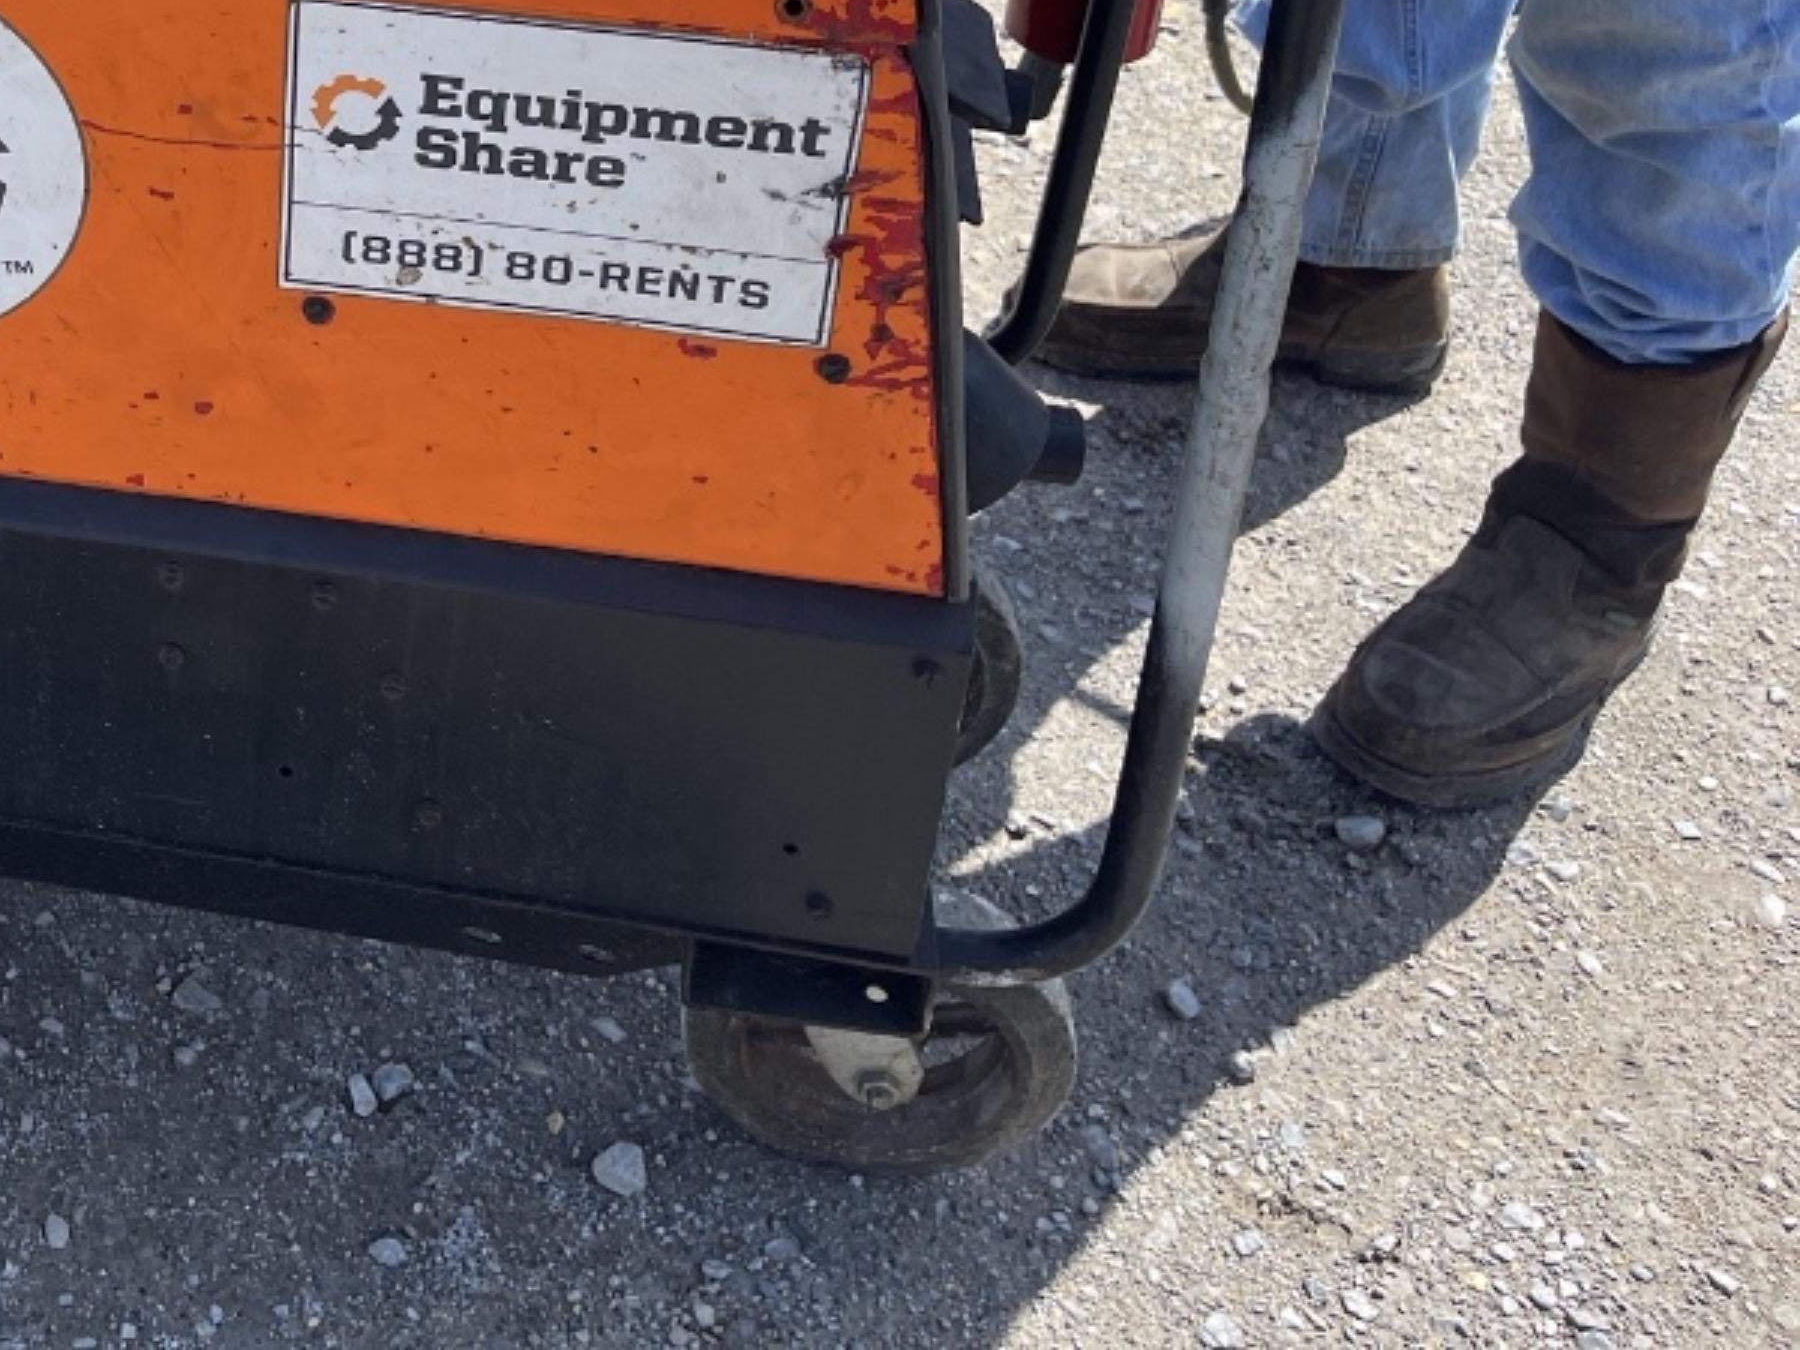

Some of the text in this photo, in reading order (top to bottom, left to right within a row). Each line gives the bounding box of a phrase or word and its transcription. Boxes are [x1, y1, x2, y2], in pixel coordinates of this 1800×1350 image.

[418, 73, 832, 157] Equipment
[414, 126, 627, 188] Share
[341, 230, 771, 310] (888) 80-RENTS
